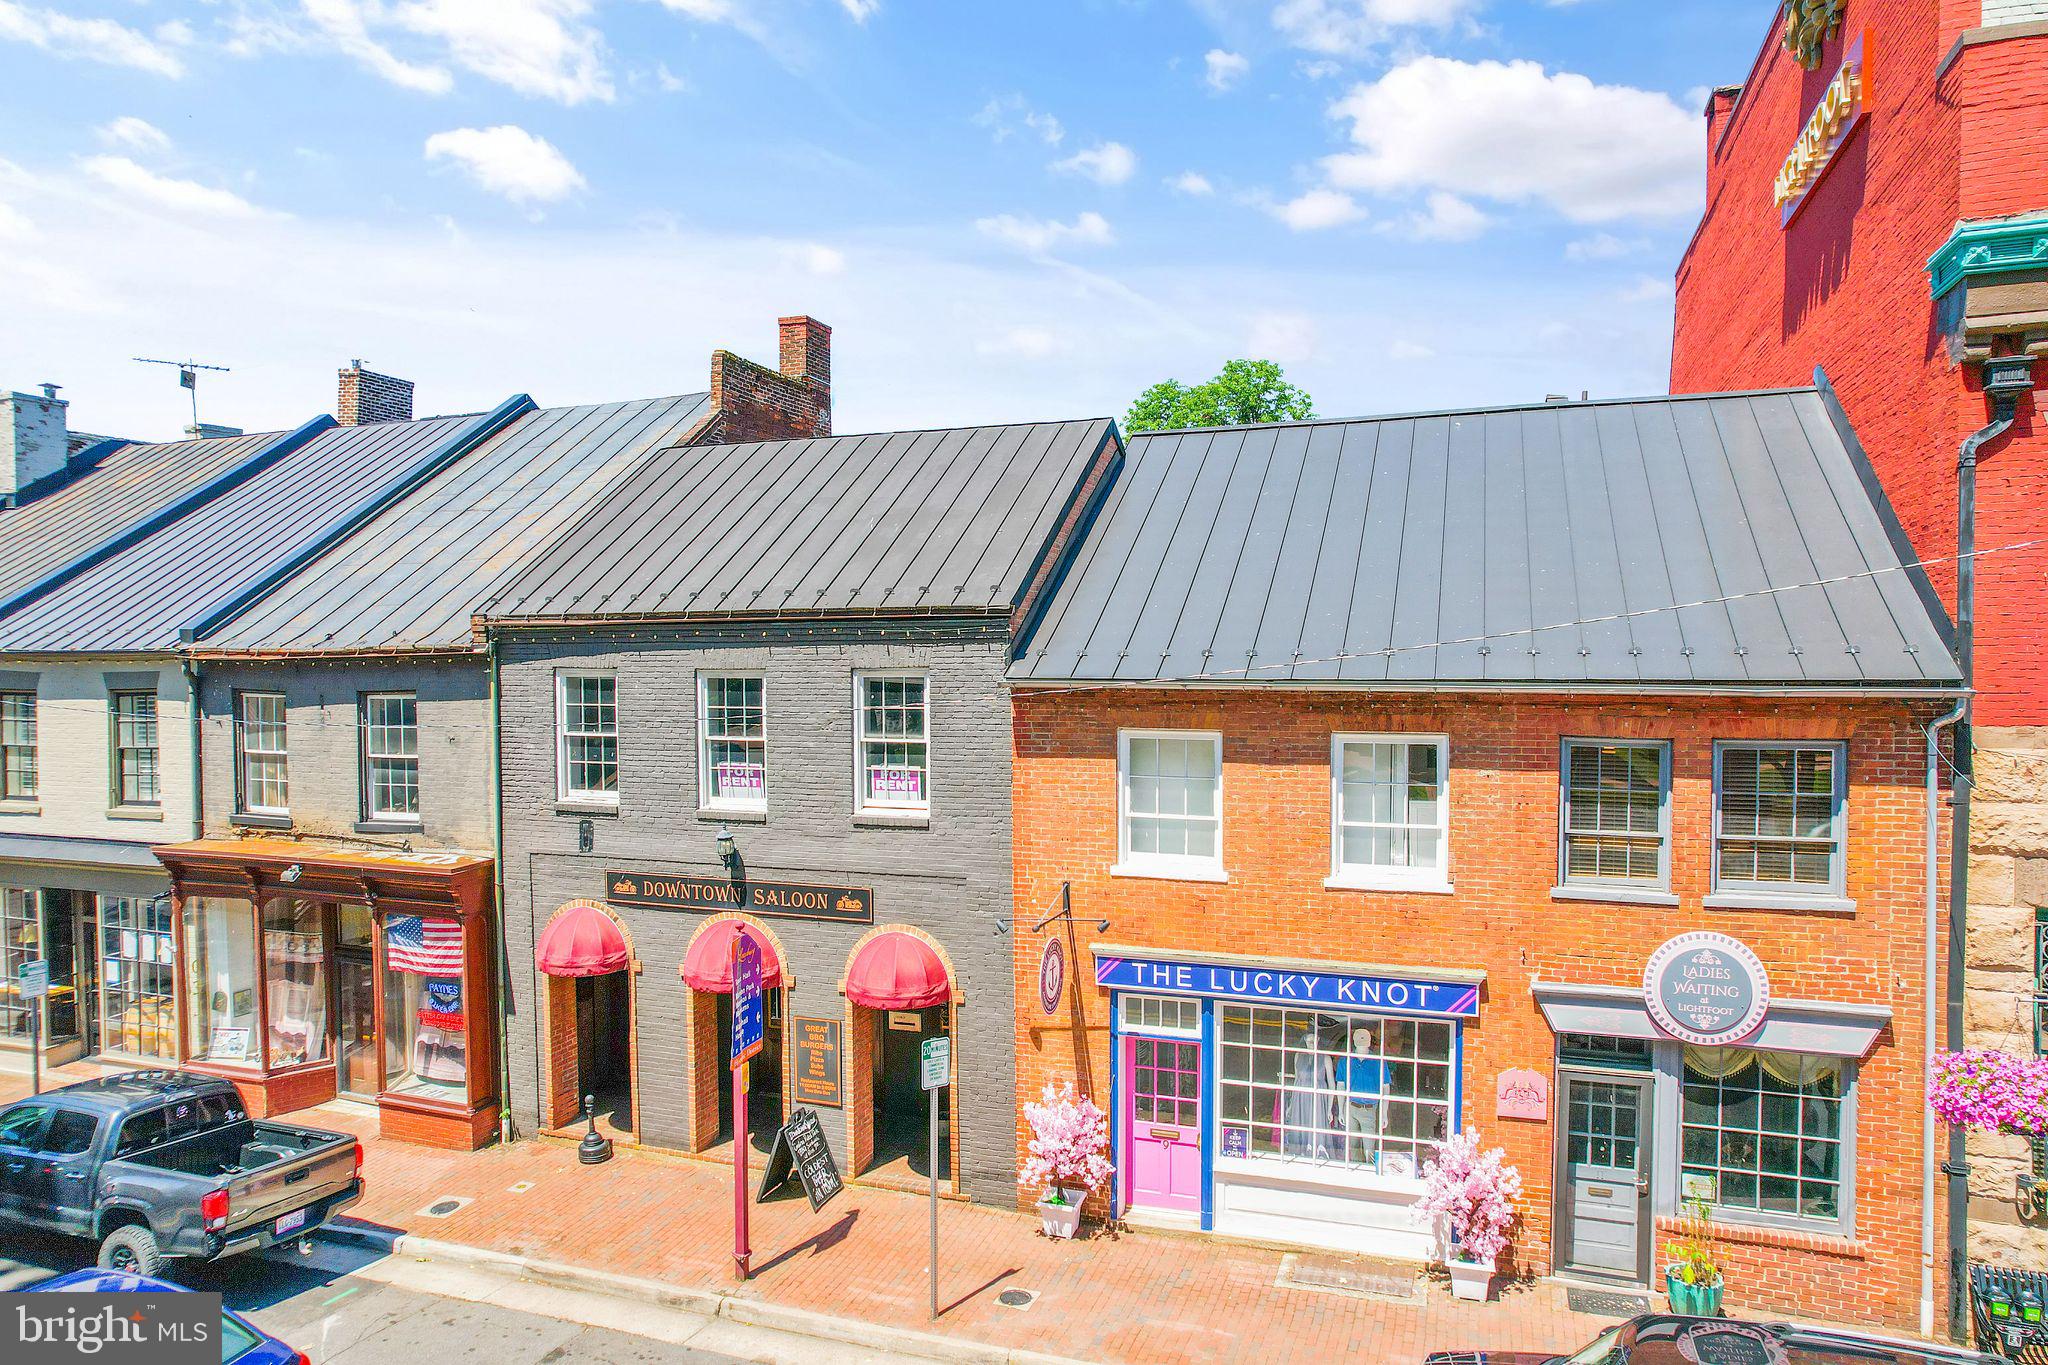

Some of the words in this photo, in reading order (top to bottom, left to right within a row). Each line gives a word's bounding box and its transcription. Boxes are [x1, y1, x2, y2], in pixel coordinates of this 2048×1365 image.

[880, 769, 911, 780] FOR
[722, 776, 760, 788] RENT
[875, 779, 917, 792] RENT
[643, 879, 744, 904] DOWNTOWN
[753, 888, 829, 910] SALOON
[1682, 965, 1731, 980] LADIES
[1131, 962, 1193, 988] THE
[1210, 968, 1320, 998] LUCKY
[1673, 980, 1740, 998] WAITING
[1678, 1003, 1734, 1016] LIGHTFOOT
[804, 1024, 829, 1034] GREAT
[808, 1033, 825, 1042] BBQ
[800, 1041, 834, 1051] BURGERS
[809, 1069, 826, 1078] Wings
[1162, 1140, 1169, 1150] 9
[1226, 1150, 1243, 1158] OPEN
[803, 1152, 829, 1179] COLDEST
